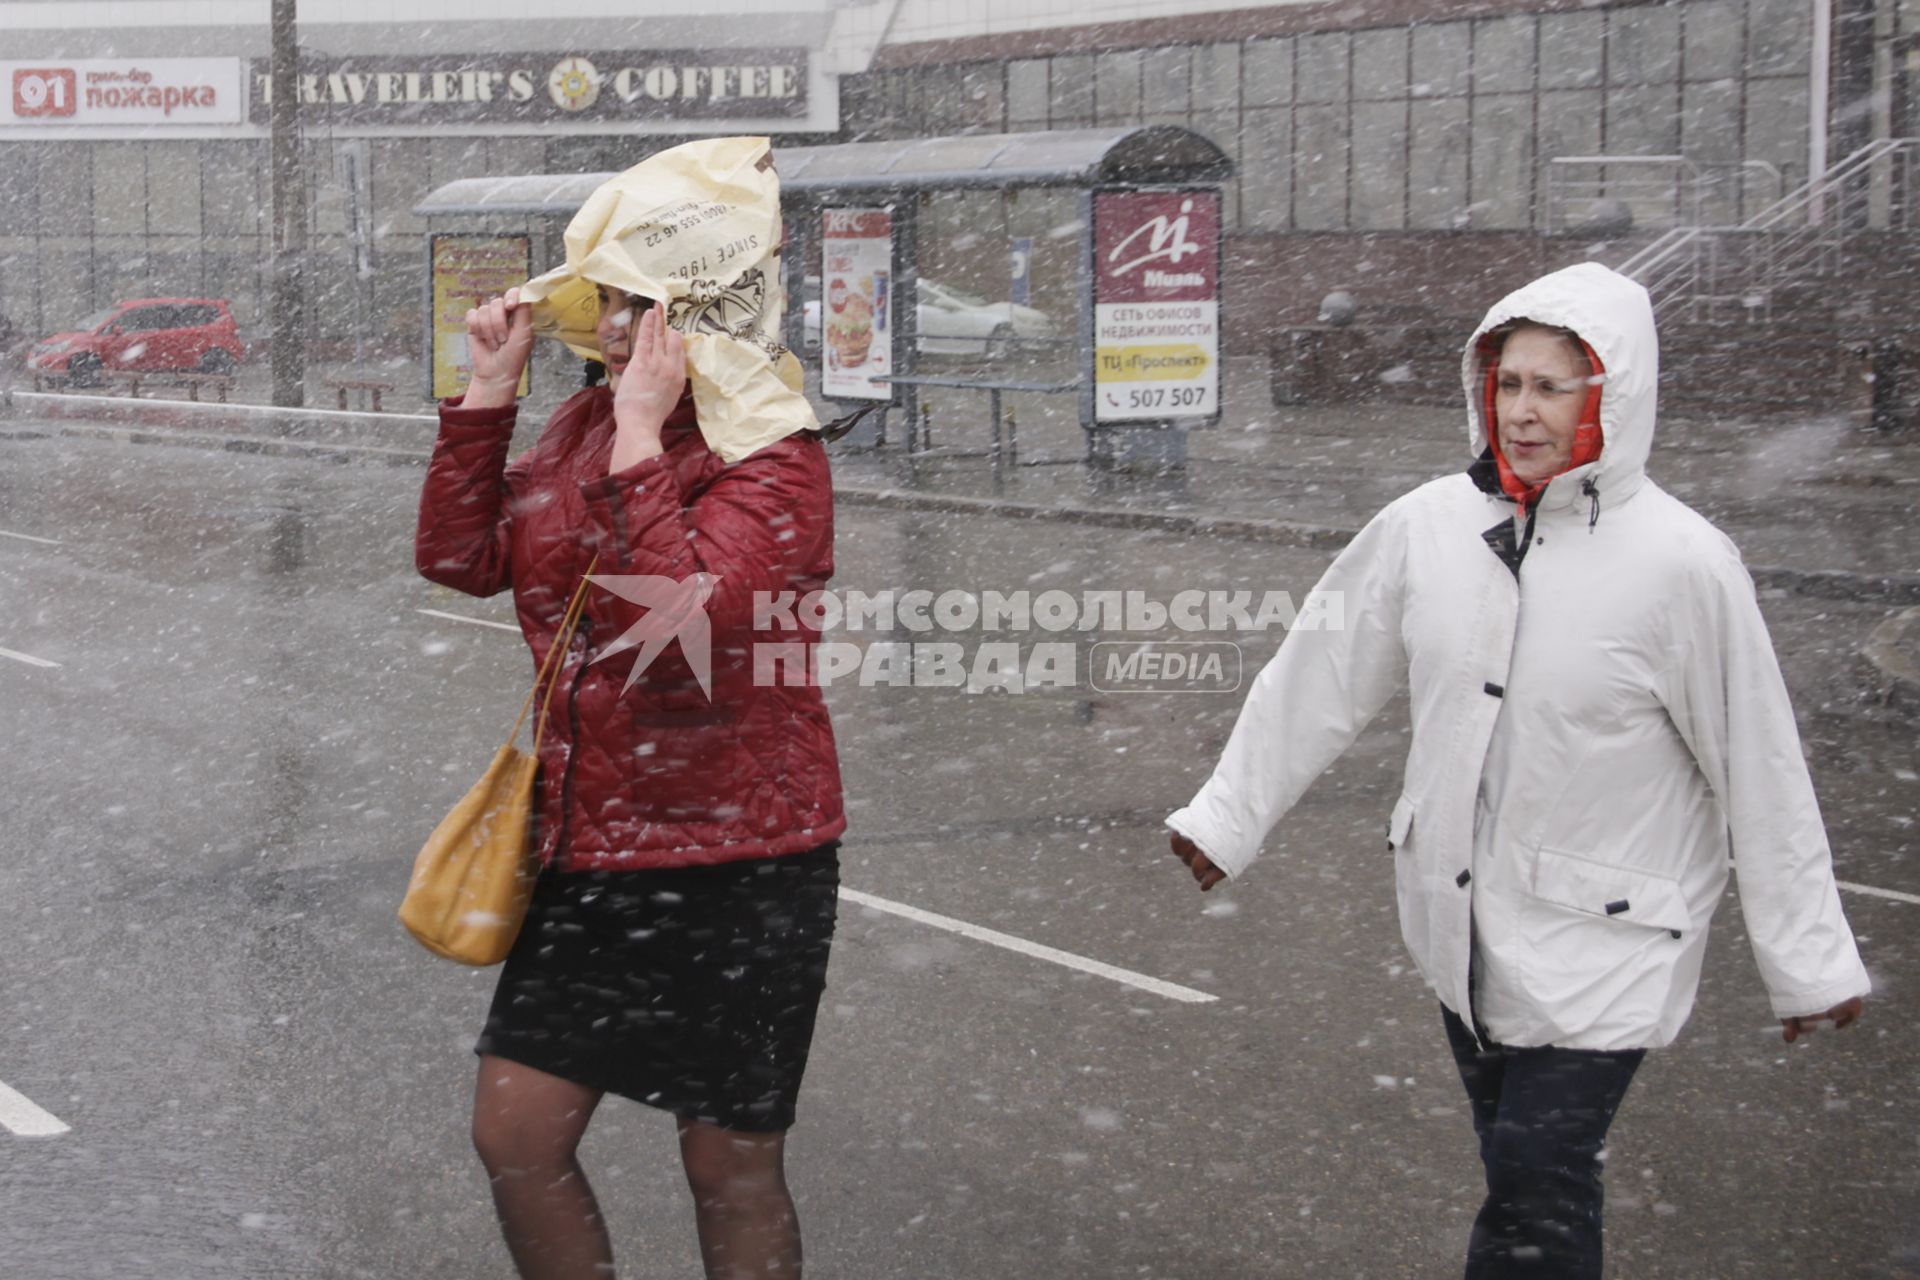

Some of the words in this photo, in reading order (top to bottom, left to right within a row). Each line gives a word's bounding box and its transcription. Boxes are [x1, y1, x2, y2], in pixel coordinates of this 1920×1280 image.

[615, 65, 798, 100] COFFEE
[85, 85, 217, 116] пожарка
[643, 231, 663, 248] 22
[662, 224, 679, 239] 46
[717, 234, 759, 264] SINCE
[1112, 308, 1144, 321] СЕТЬ
[1146, 307, 1202, 320] ОФИСОВ
[1101, 323, 1212, 340] НЕДВИЖИМОСТИ
[1103, 354, 1122, 372] ТЦ
[1130, 388, 1165, 408] 507
[1171, 386, 1206, 407] 507
